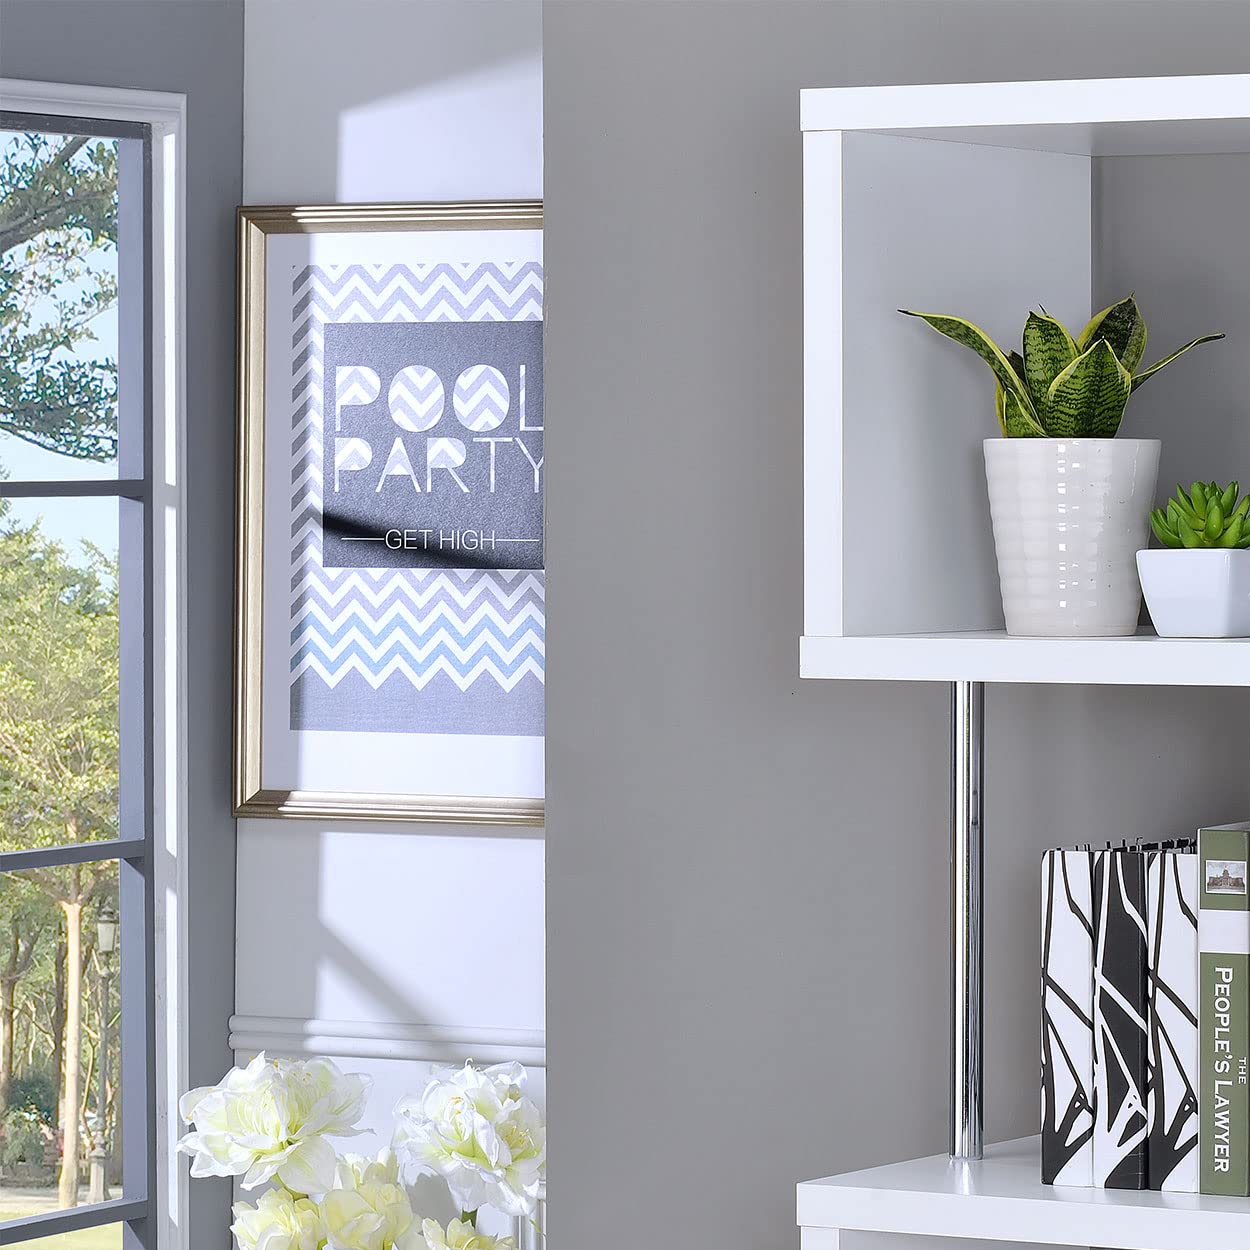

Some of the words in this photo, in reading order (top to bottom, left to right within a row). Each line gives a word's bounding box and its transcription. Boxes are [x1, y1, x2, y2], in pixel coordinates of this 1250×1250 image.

[335, 364, 544, 432] POOL
[334, 437, 544, 493] PARTY
[385, 529, 433, 550] GET
[439, 530, 495, 550] HIGH
[1214, 967, 1234, 1074] PEOPLE'S
[1238, 1056, 1247, 1085] THE
[1214, 1079, 1233, 1173] LAWYER
